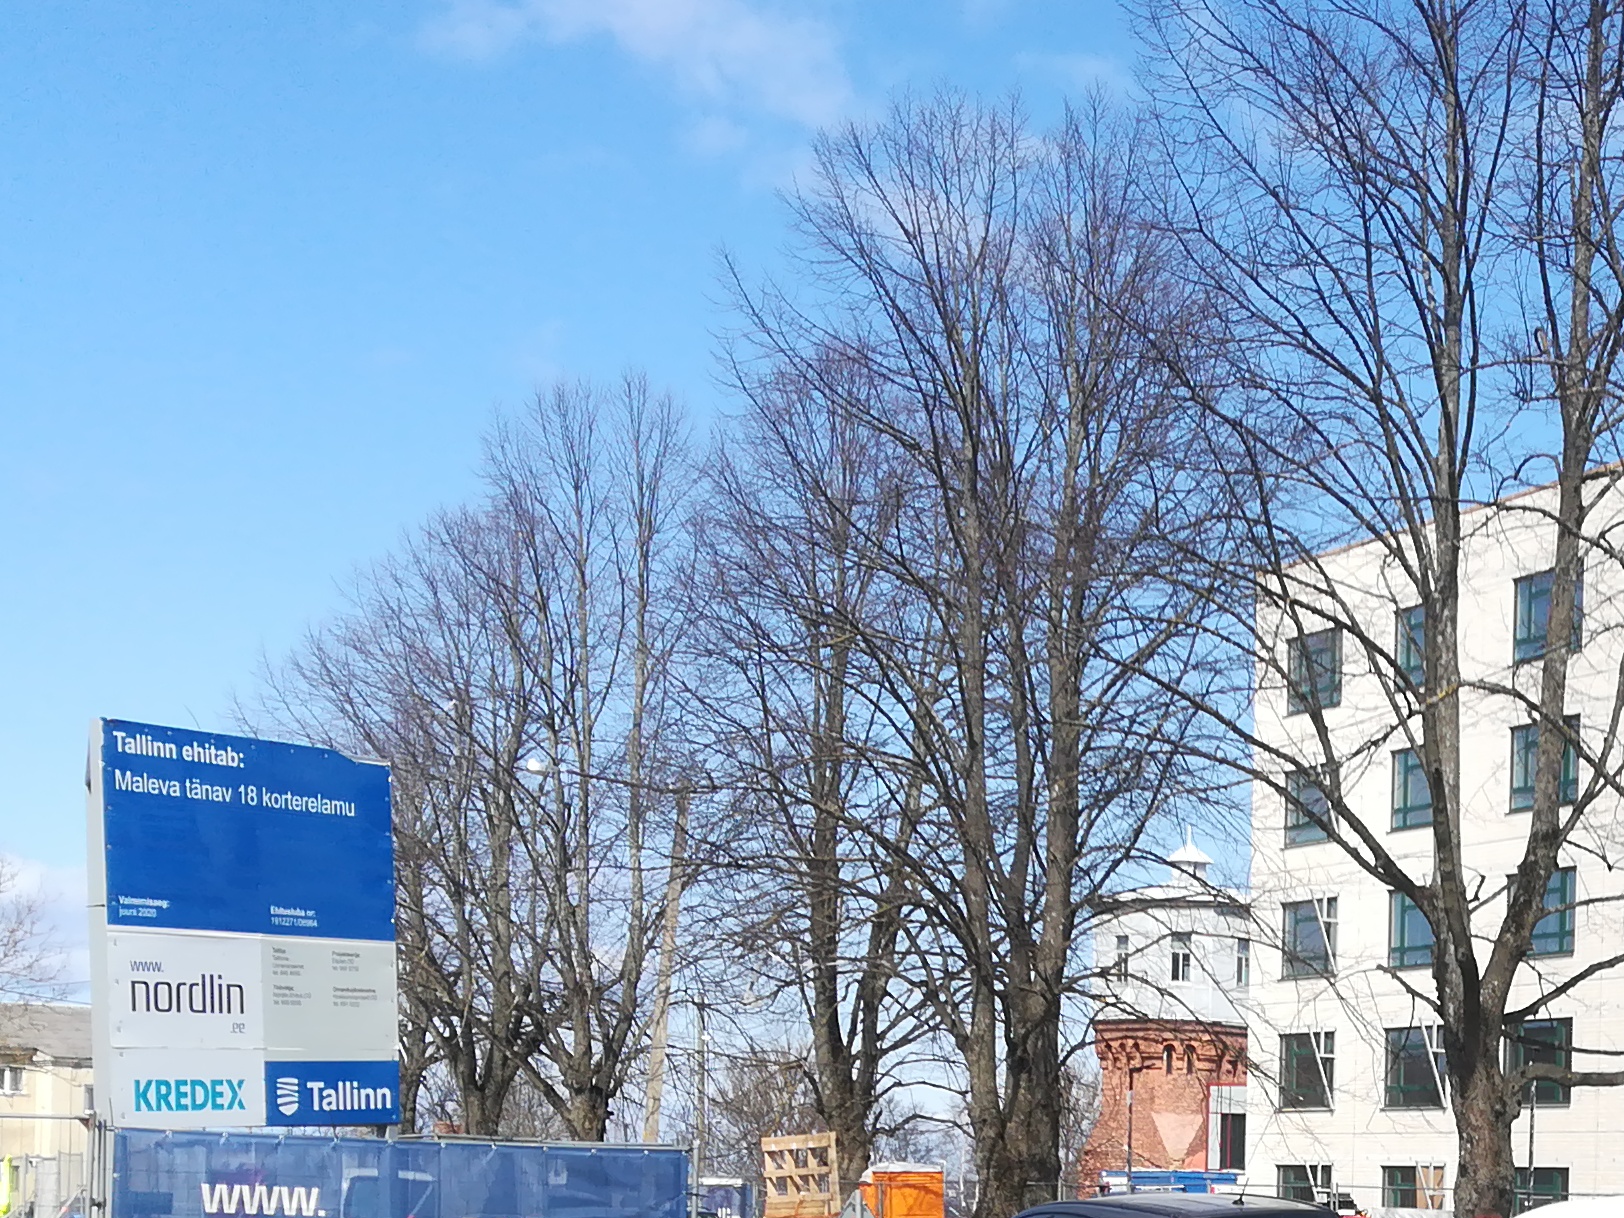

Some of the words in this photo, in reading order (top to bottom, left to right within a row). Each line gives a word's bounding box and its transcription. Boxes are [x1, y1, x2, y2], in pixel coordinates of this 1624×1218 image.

[113, 731, 177, 759] Tallinn
[182, 741, 245, 768] ehitab:
[115, 769, 180, 797] Maleva
[185, 778, 232, 803] tänav
[239, 784, 257, 806] 18
[263, 787, 355, 817] korterelamu
[130, 960, 164, 973] www.
[131, 973, 245, 1014] nordlin
[134, 1078, 246, 1112] KREDEX
[307, 1081, 391, 1111] Tallinn
[200, 1182, 327, 1218] www.
